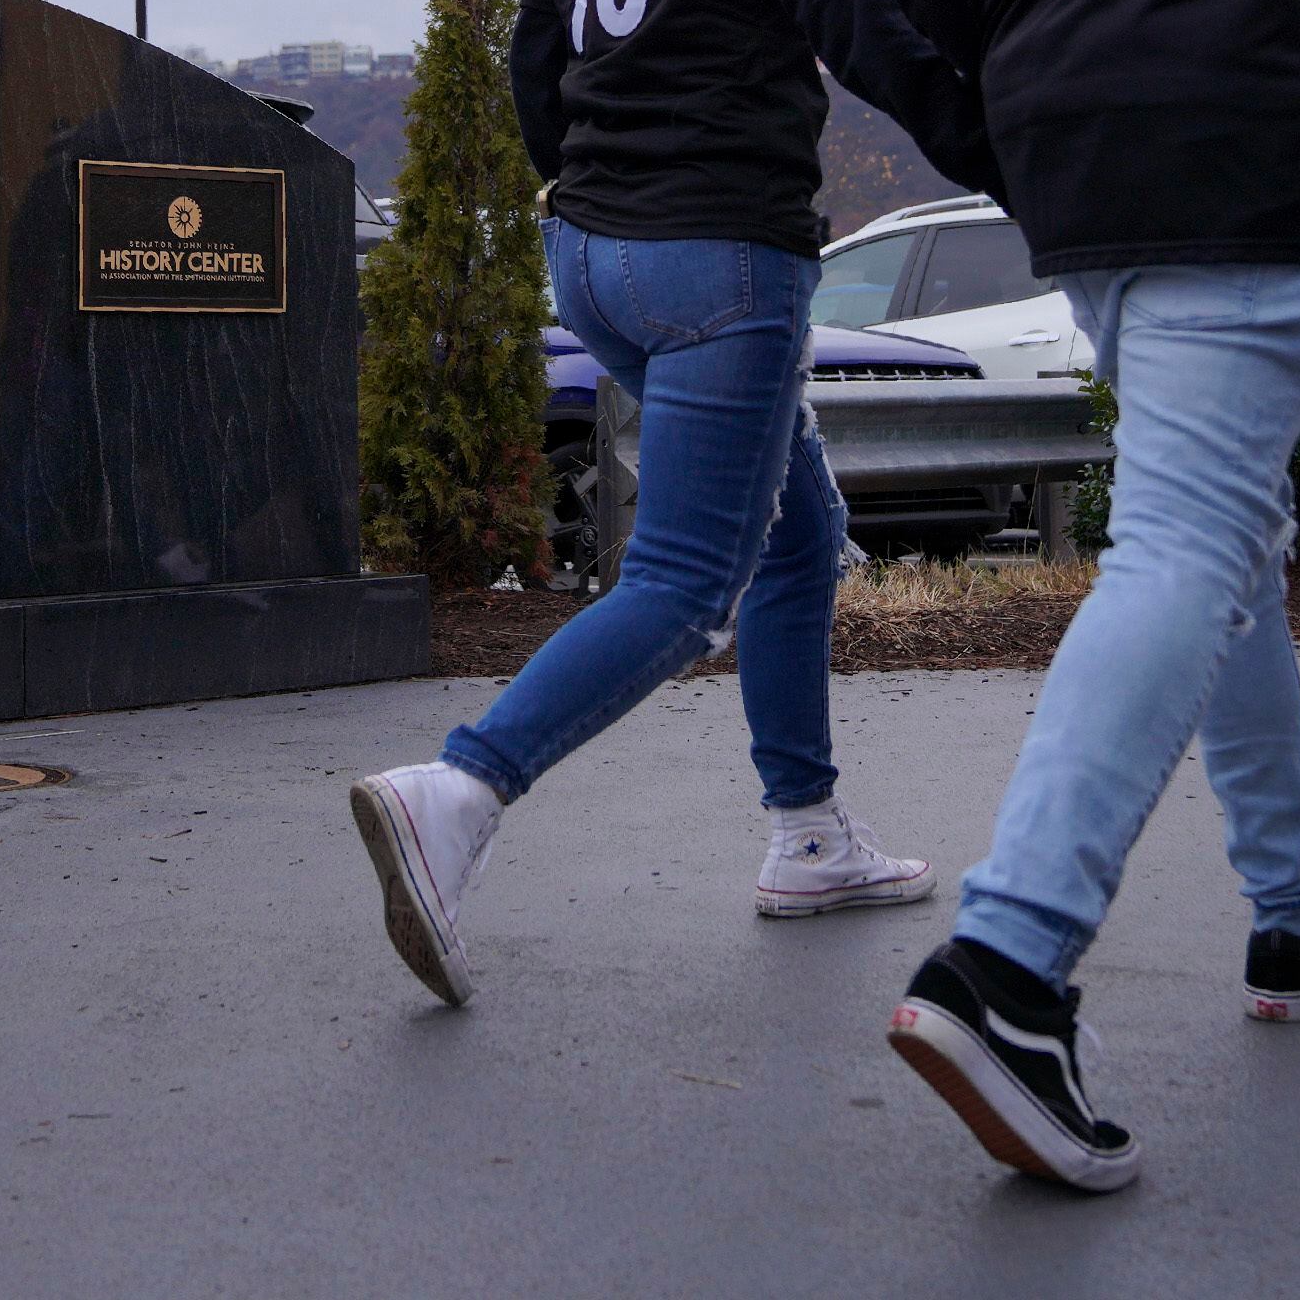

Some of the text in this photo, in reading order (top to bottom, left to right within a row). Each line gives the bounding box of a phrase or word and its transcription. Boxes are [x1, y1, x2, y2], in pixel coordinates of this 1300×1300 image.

[129, 240, 235, 250] SENATOR JOHN HEINZ
[100, 249, 265, 274] HISTORY CENTER
[108, 273, 152, 281] ASSOCIATION
[184, 274, 227, 282] SMITHSONIAN
[227, 275, 265, 283] INSTITUTION
